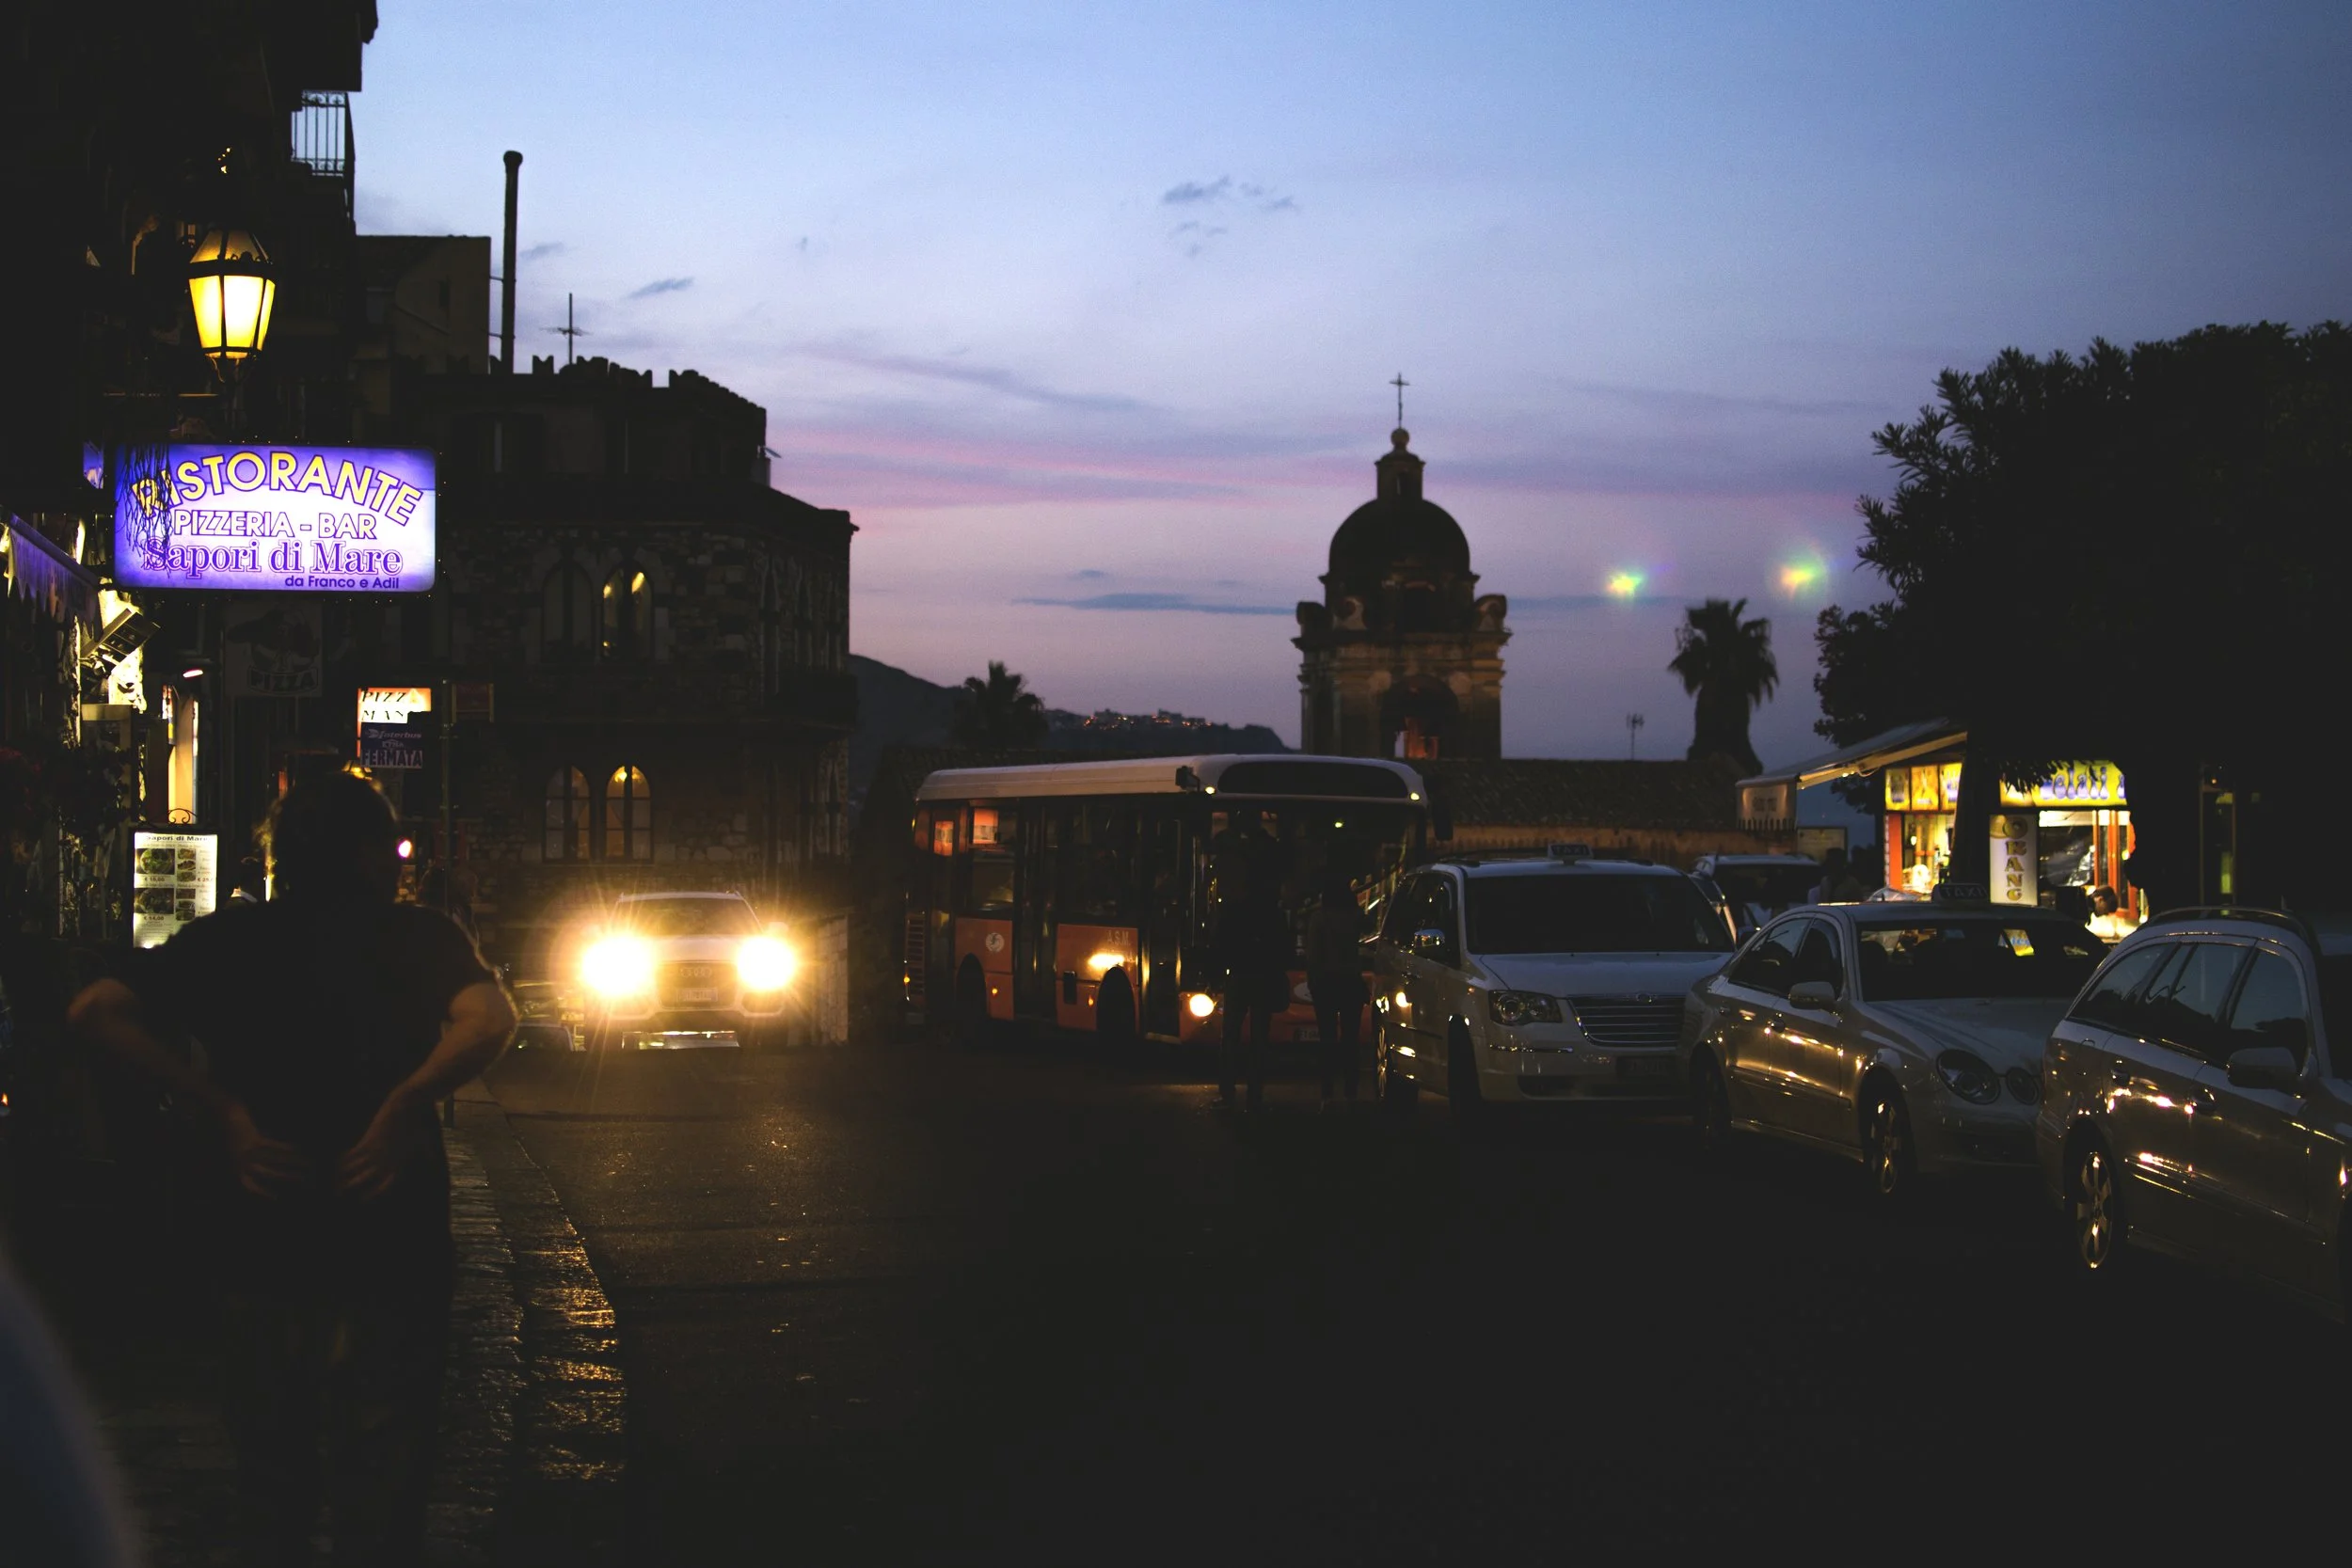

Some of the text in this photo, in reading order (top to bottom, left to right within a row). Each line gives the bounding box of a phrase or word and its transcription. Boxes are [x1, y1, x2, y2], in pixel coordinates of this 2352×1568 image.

[132, 451, 422, 527] RISTORANTE
[173, 510, 294, 538] PIZZERIA
[318, 514, 377, 540] BAR
[143, 537, 404, 578] Sapori di Mare
[284, 576, 399, 590] da Franco e Adil
[361, 749, 423, 767] FERMATA
